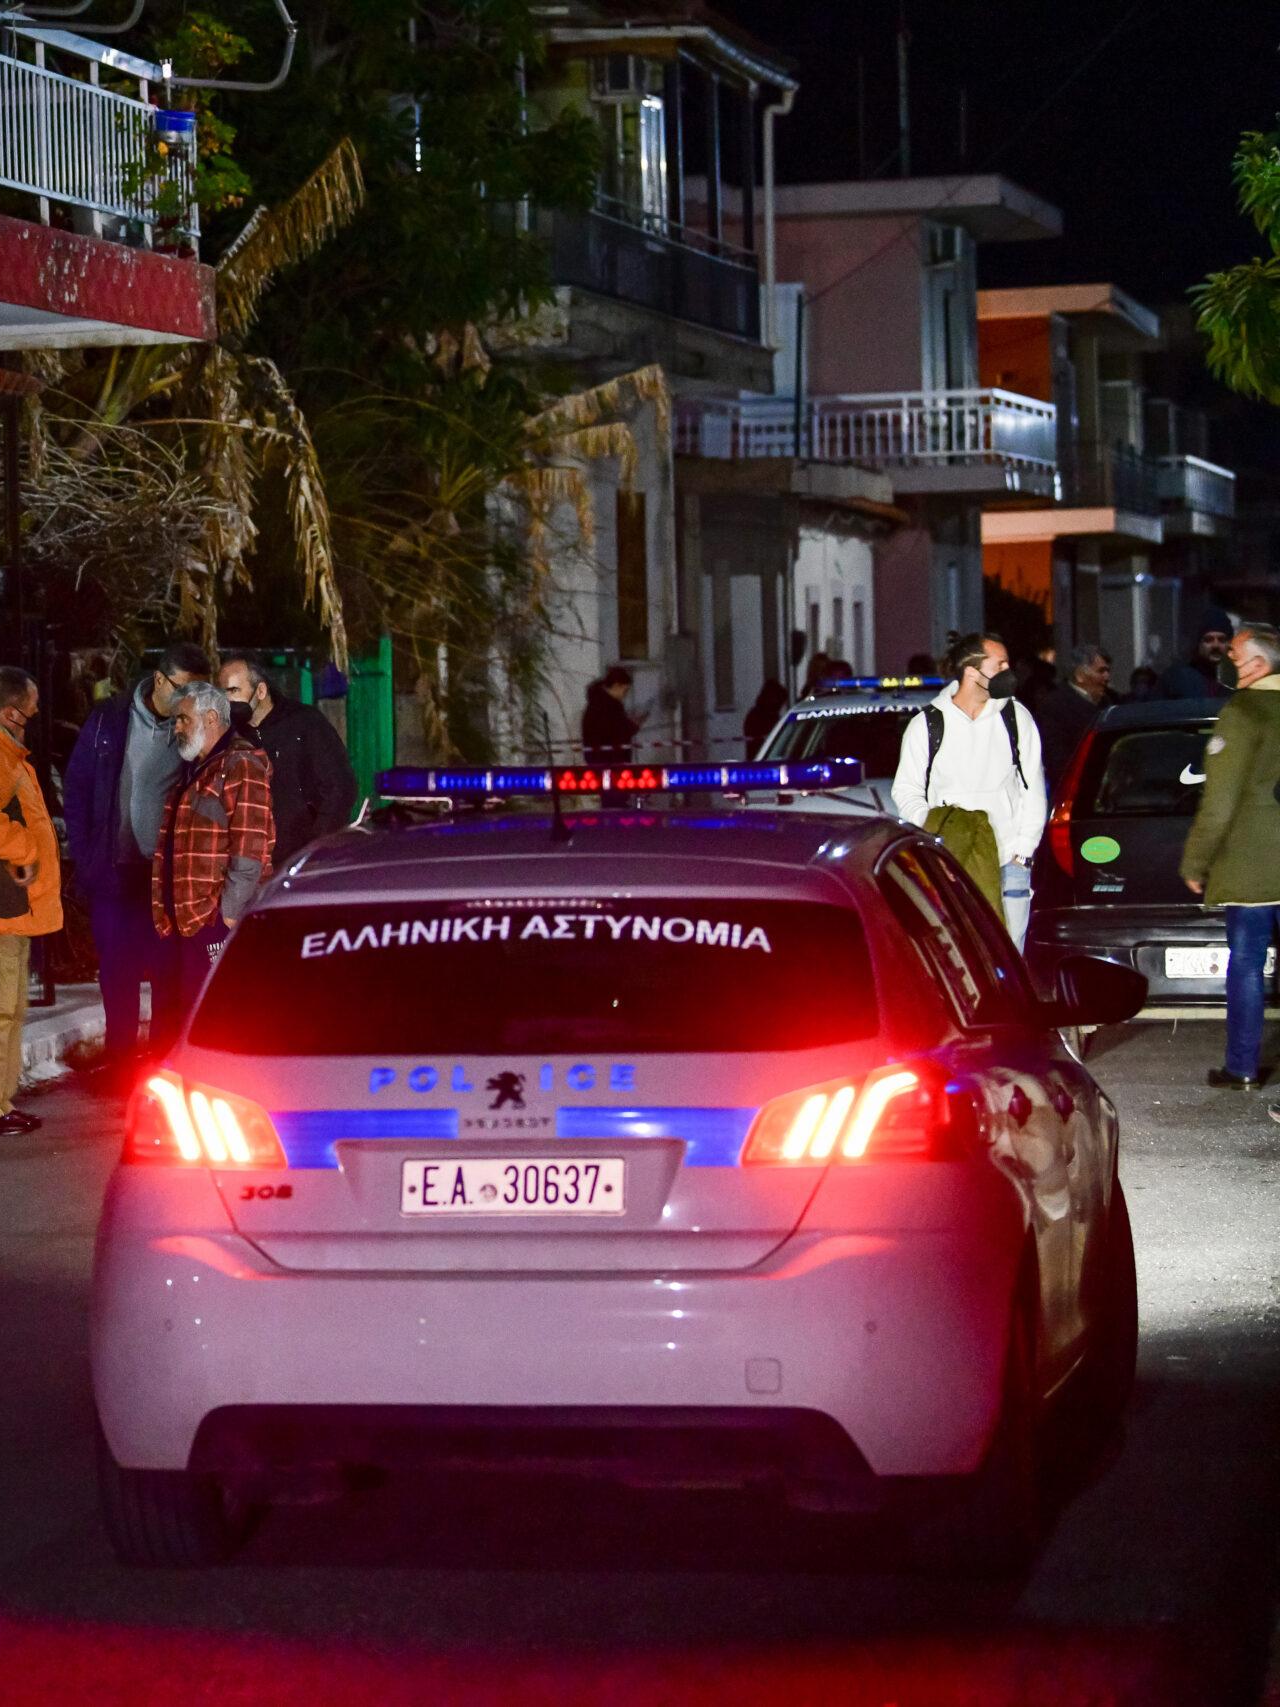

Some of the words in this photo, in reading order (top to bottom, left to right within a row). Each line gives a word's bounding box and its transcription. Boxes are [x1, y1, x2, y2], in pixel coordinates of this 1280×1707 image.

[300, 915, 510, 959] ΕΛΛΗΝΙΚΗ
[520, 914, 772, 953] ΑΣΤΥΝΟΜΙΑ
[503, 1165, 600, 1204] 30637
